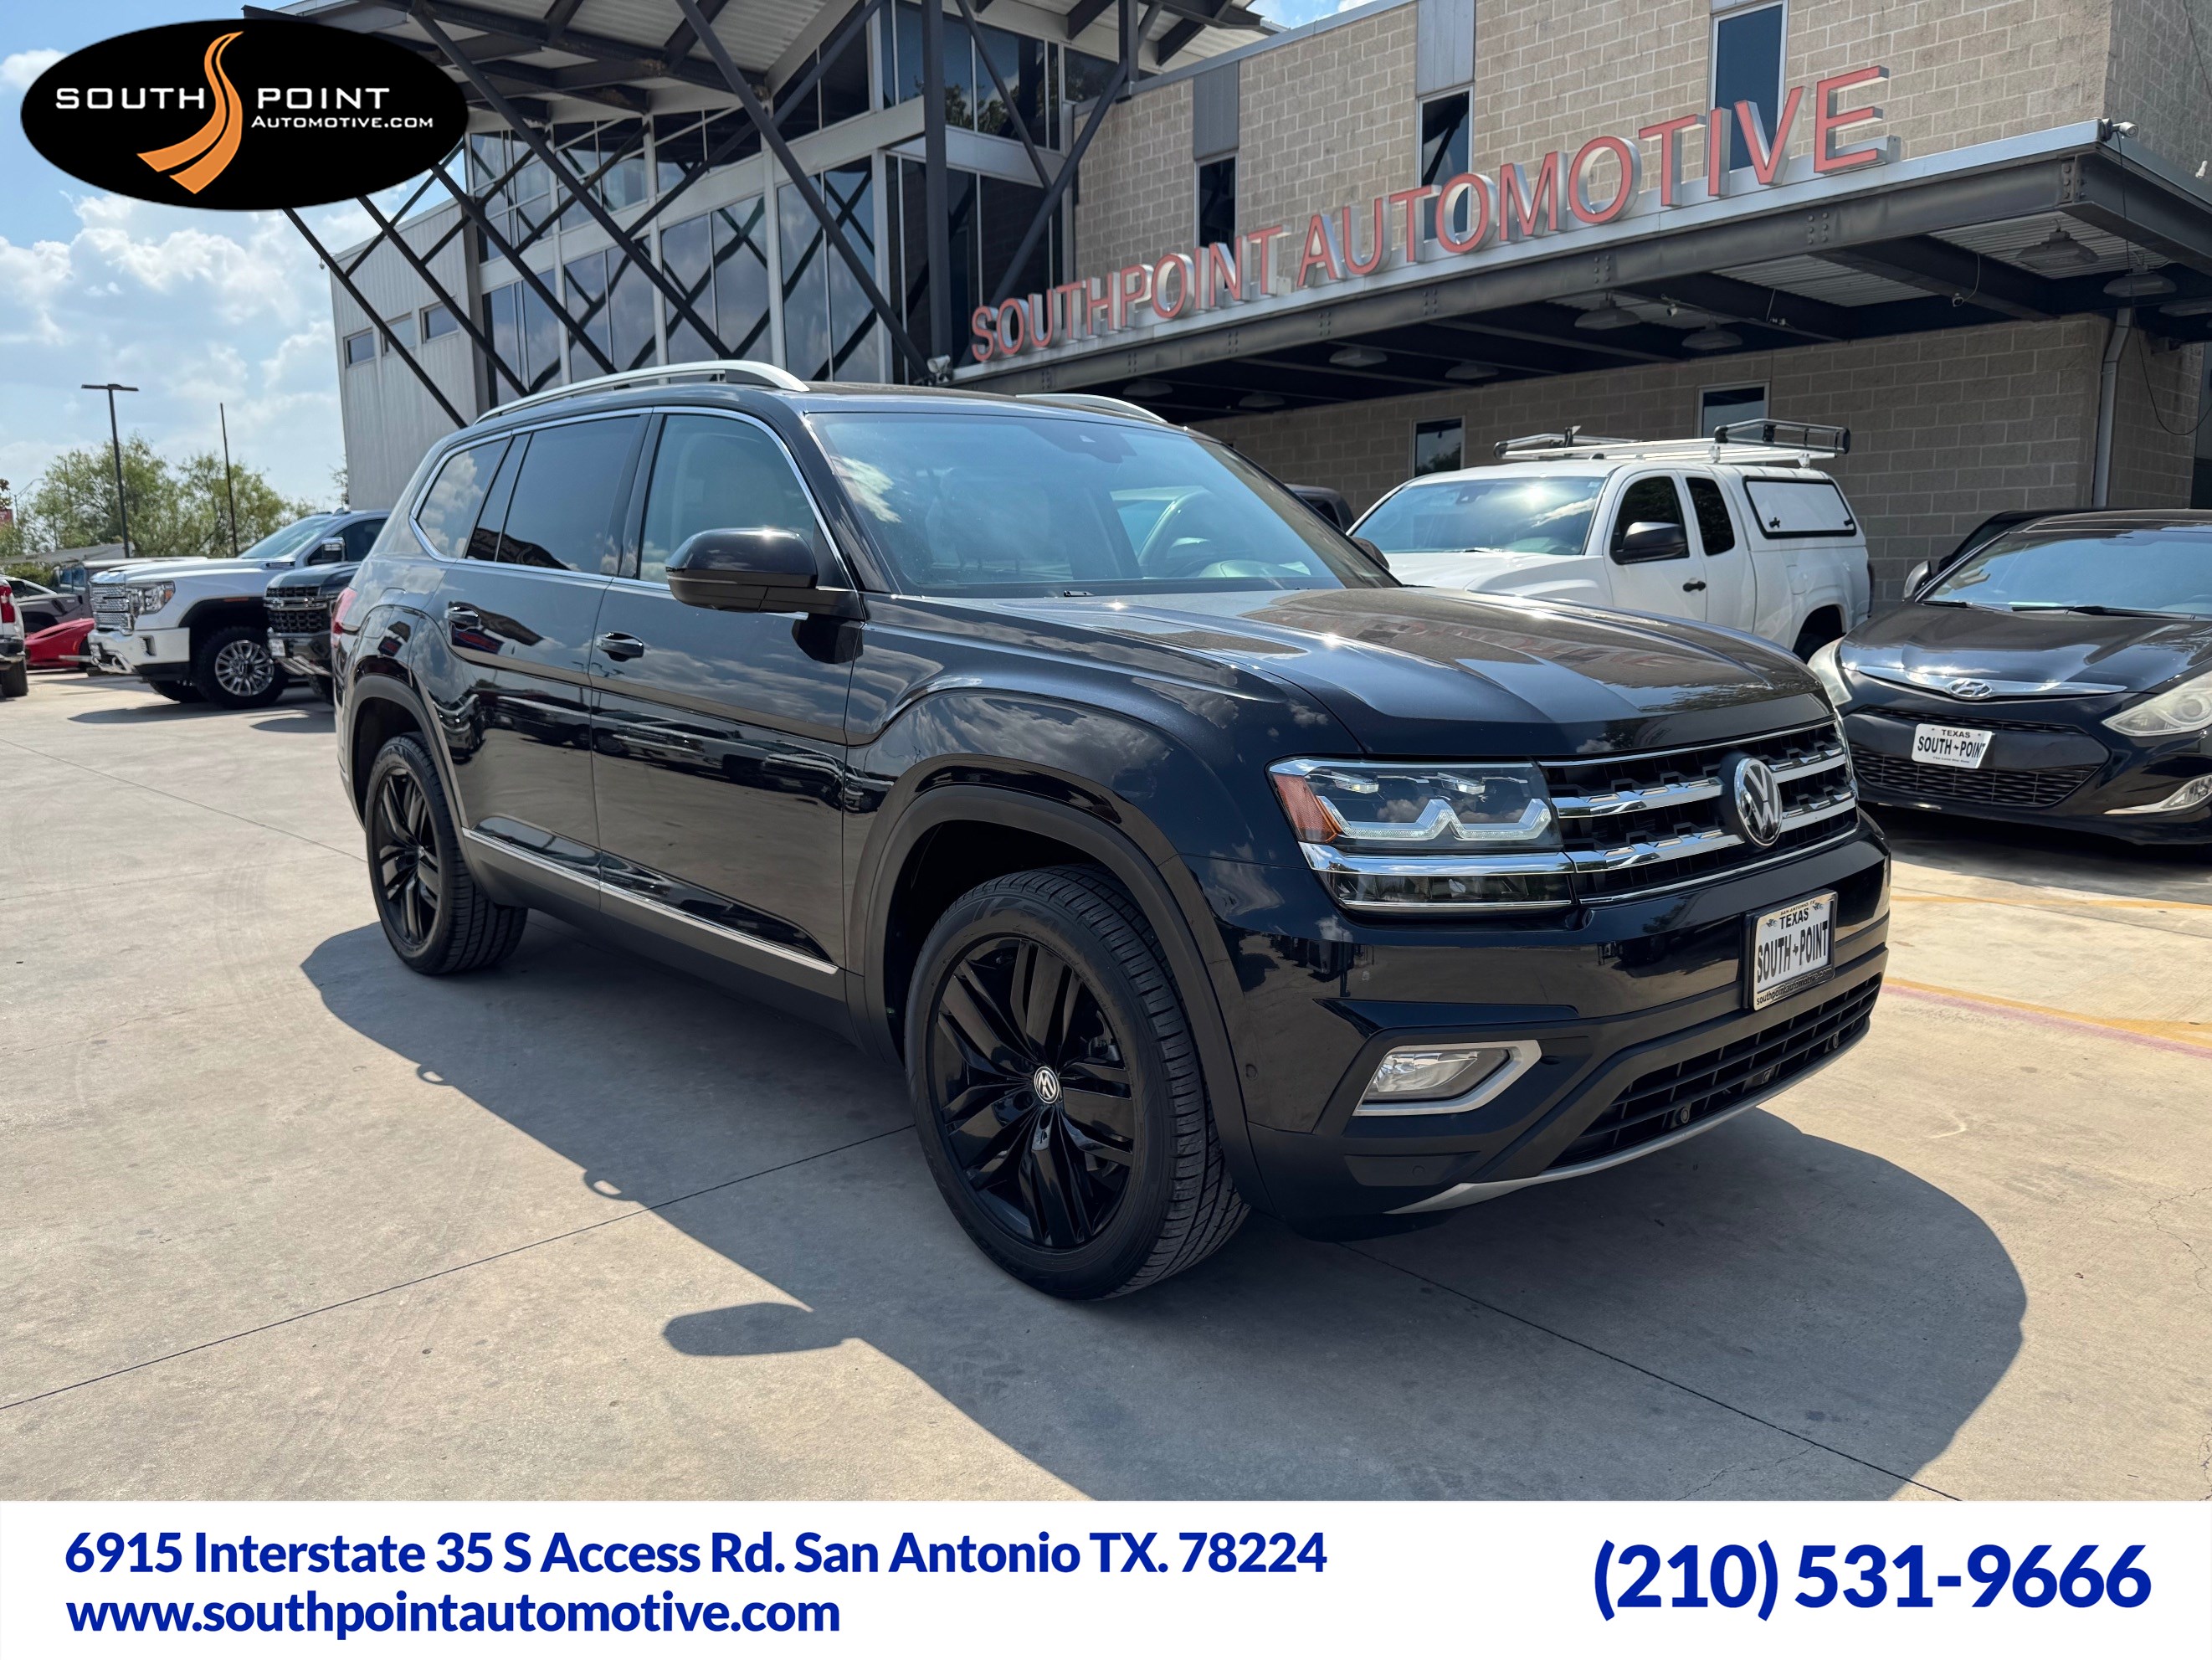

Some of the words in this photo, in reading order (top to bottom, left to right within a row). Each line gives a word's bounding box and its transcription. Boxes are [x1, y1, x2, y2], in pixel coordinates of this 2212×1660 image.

[972, 224, 1291, 362] SOUTHPOINT
[1296, 65, 1889, 287] AUTOMOTIVE
[1941, 728, 1971, 738] TEXAS
[1917, 736, 1952, 755] SOUTH
[1779, 907, 1809, 930] TEXAS
[1758, 933, 1792, 984] SOUTH
[1799, 920, 1828, 965] POINT
